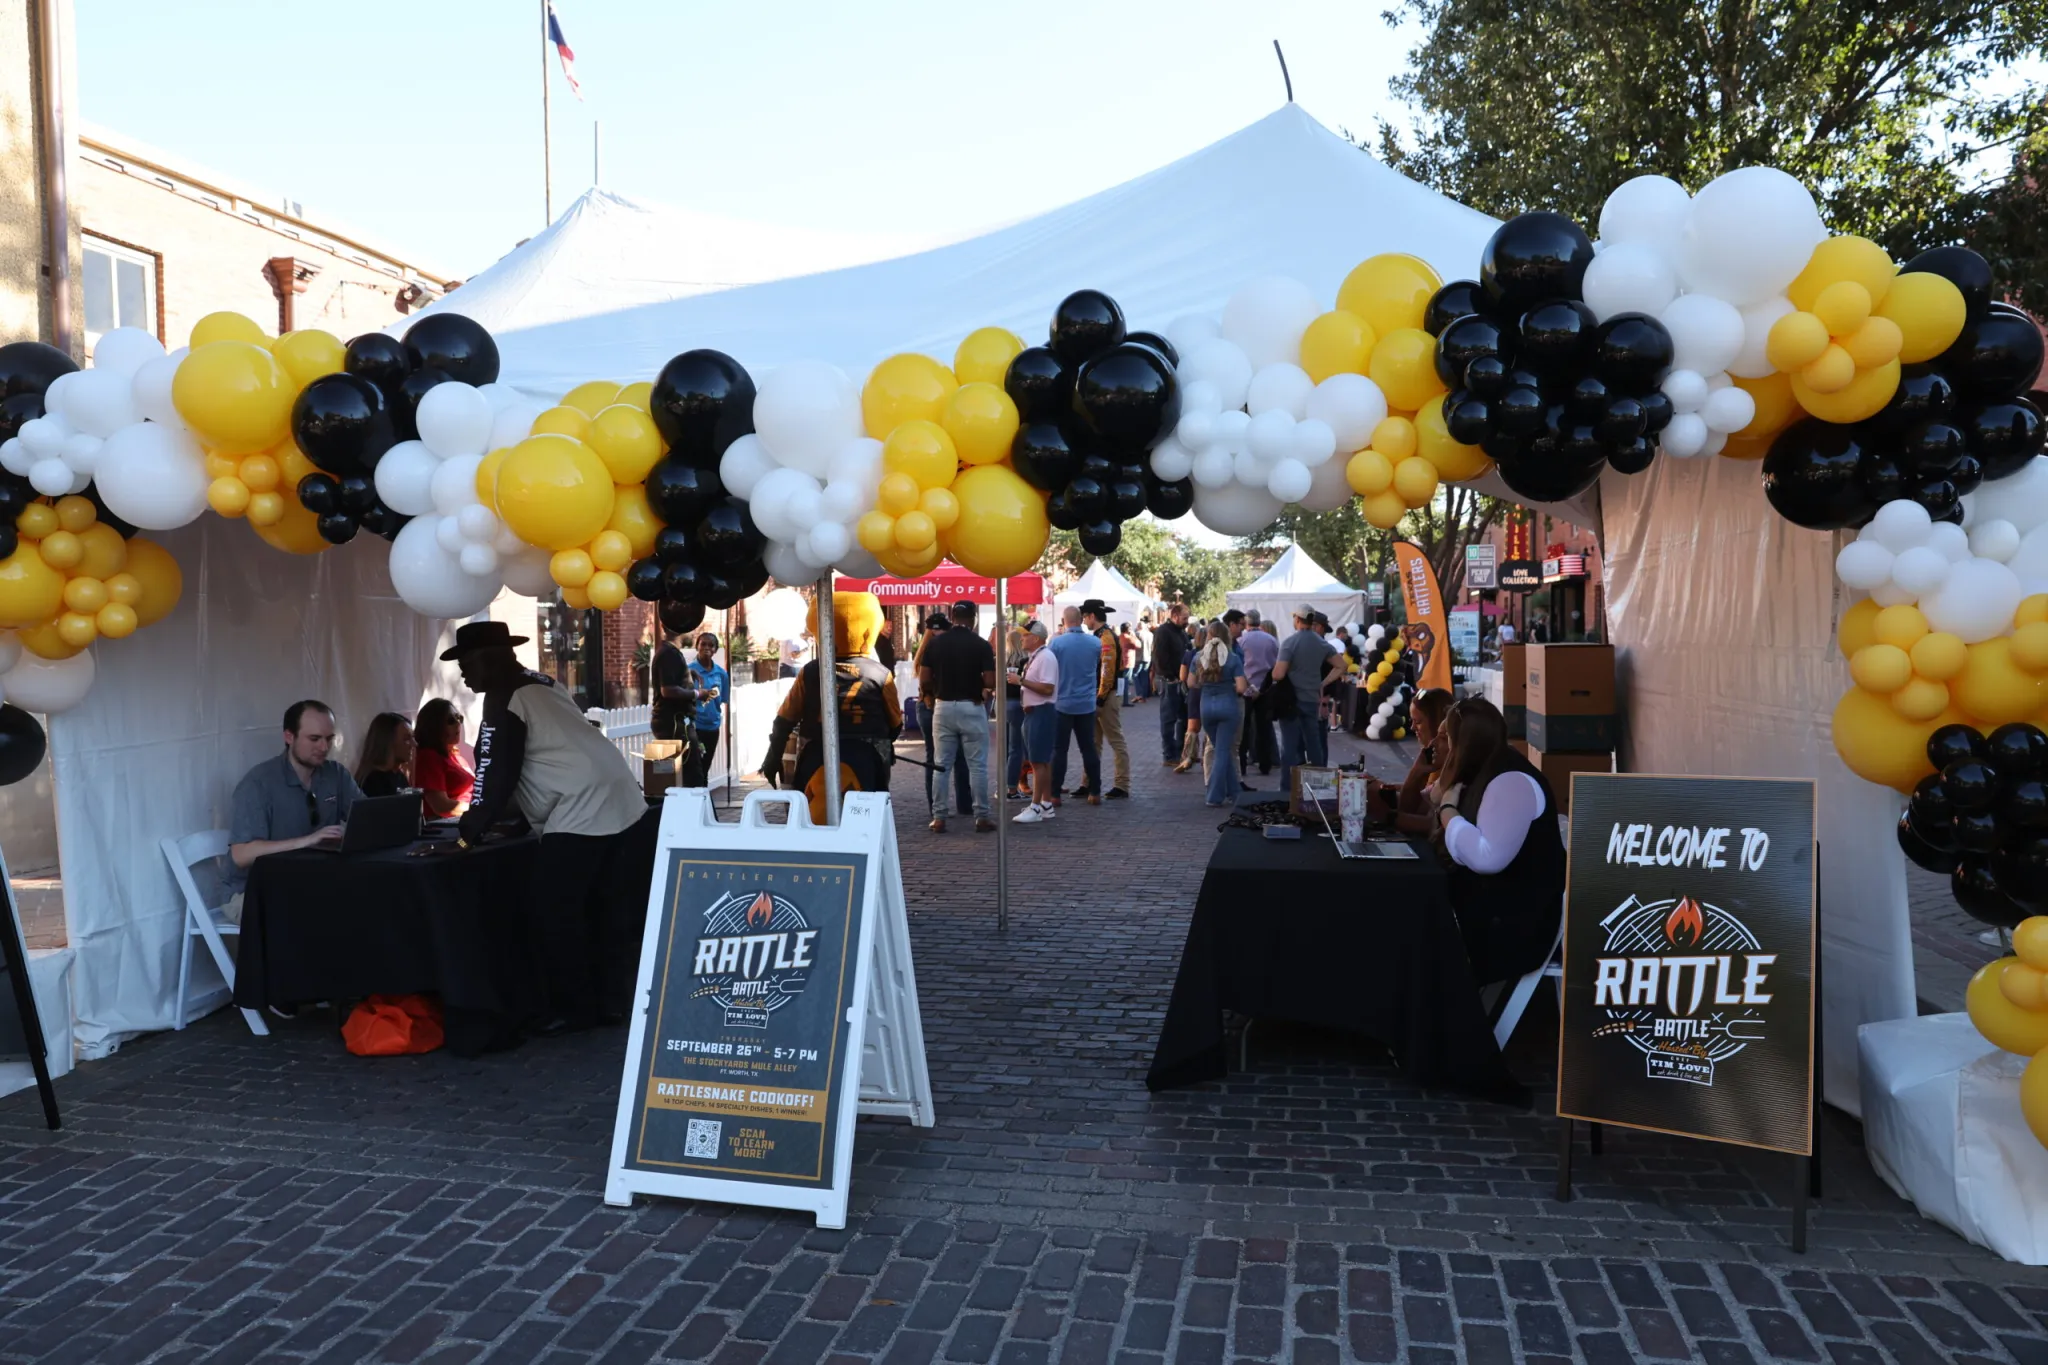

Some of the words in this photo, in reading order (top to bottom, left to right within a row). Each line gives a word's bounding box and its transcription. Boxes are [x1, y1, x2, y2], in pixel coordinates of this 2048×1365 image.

[1502, 576, 1539, 585] COLLECTION
[1513, 568, 1529, 577] LOVE
[867, 579, 942, 598] Community
[944, 585, 1008, 595] COFFE
[1410, 557, 1431, 616] RATTLERS
[481, 721, 496, 754] JACK
[1606, 822, 1731, 870] WELCOME
[1739, 827, 1770, 872] TO
[688, 871, 773, 882] RATTLER
[793, 875, 841, 884] DAYS
[693, 930, 818, 979] RATTLE
[732, 980, 771, 998] BATTLE
[1594, 954, 1779, 1016] RATTLE
[1654, 1018, 1711, 1041] BATTLE
[666, 1039, 733, 1056] SEPTEMBER
[774, 1047, 796, 1060] 5-7
[799, 1049, 818, 1061] PM
[683, 1056, 697, 1065] THE
[699, 1057, 749, 1069] STOCKYARDS
[751, 1061, 772, 1071] MULE
[774, 1063, 798, 1073] ALLEY
[1650, 1059, 1674, 1069] TIM
[1677, 1062, 1710, 1074] LOVE
[657, 1082, 746, 1102] RATTLESNAKE
[749, 1090, 815, 1108] COOKOFF!
[716, 1103, 749, 1111] SPECIALTY
[739, 1127, 766, 1139] SCAN
[728, 1136, 741, 1147] TO
[743, 1138, 775, 1150] LEARN
[734, 1147, 766, 1159] MORE!
